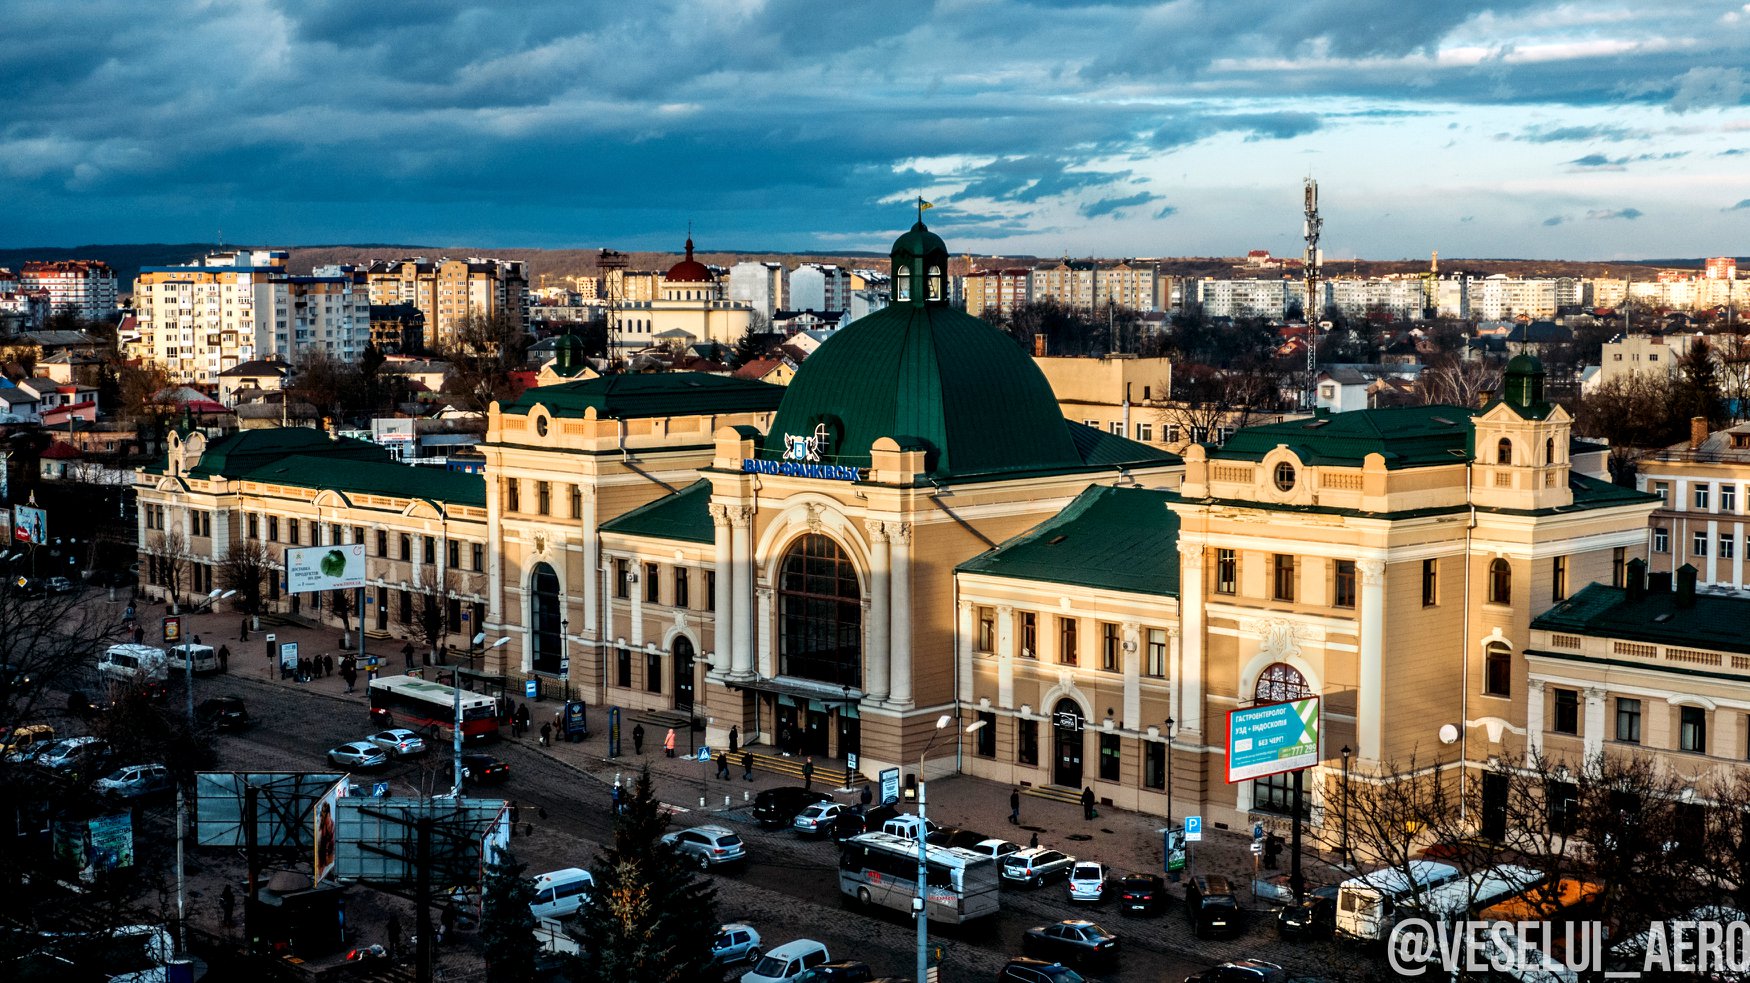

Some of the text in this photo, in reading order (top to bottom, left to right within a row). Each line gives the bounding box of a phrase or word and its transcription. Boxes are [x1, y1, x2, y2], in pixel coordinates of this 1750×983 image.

[1235, 708, 1287, 722] ГАСТРОЕНТЕРОЛОГ
[1235, 726, 1248, 735] УЗД
[1258, 738, 1269, 747] БЕЗ
[1291, 746, 1304, 758] 777
[1304, 743, 1317, 753] 299
[1189, 819, 1198, 831] P
